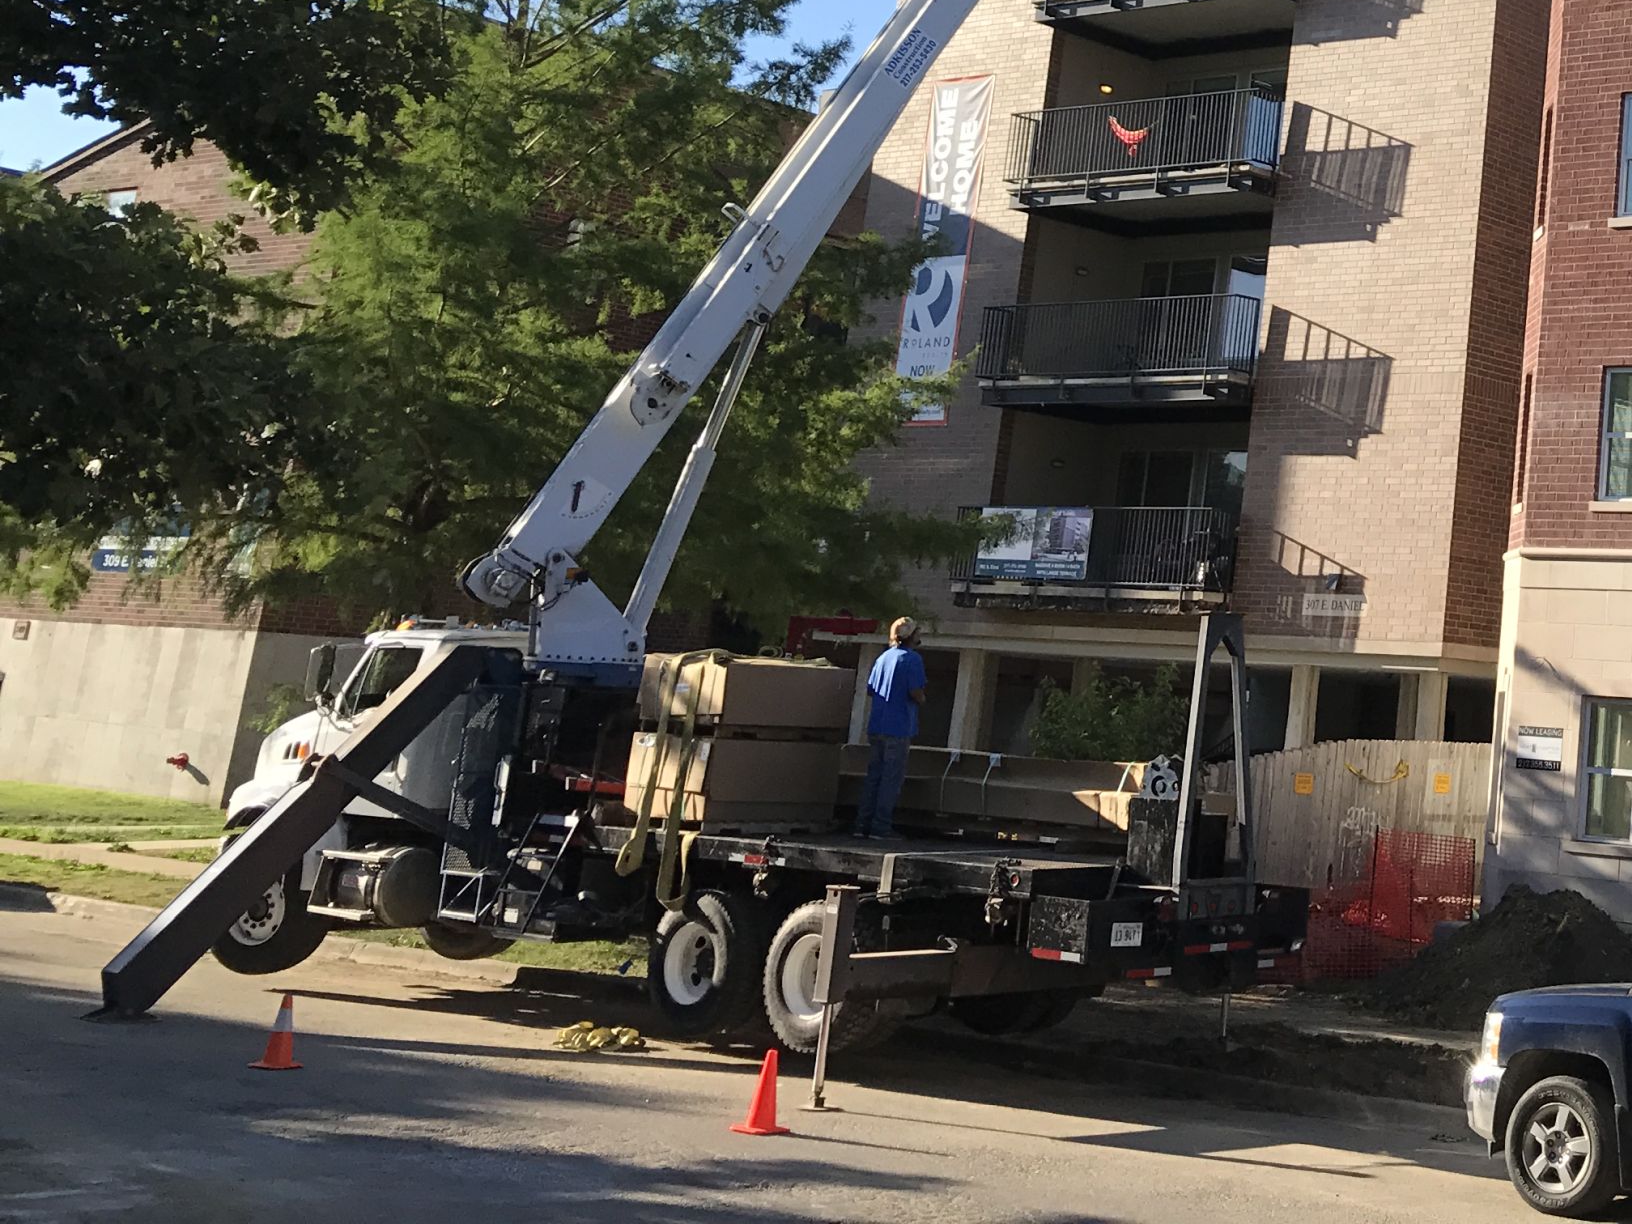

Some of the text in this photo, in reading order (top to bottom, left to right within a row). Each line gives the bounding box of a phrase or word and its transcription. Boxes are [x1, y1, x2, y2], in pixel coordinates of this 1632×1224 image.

[884, 27, 922, 76] ADKISSON
[949, 119, 980, 216] HOME
[902, 336, 951, 349] ROLAND
[102, 553, 120, 567] 309
[131, 554, 159, 569] aniel
[1331, 599, 1364, 612] DANIEL
[1535, 727, 1563, 737] LEASING
